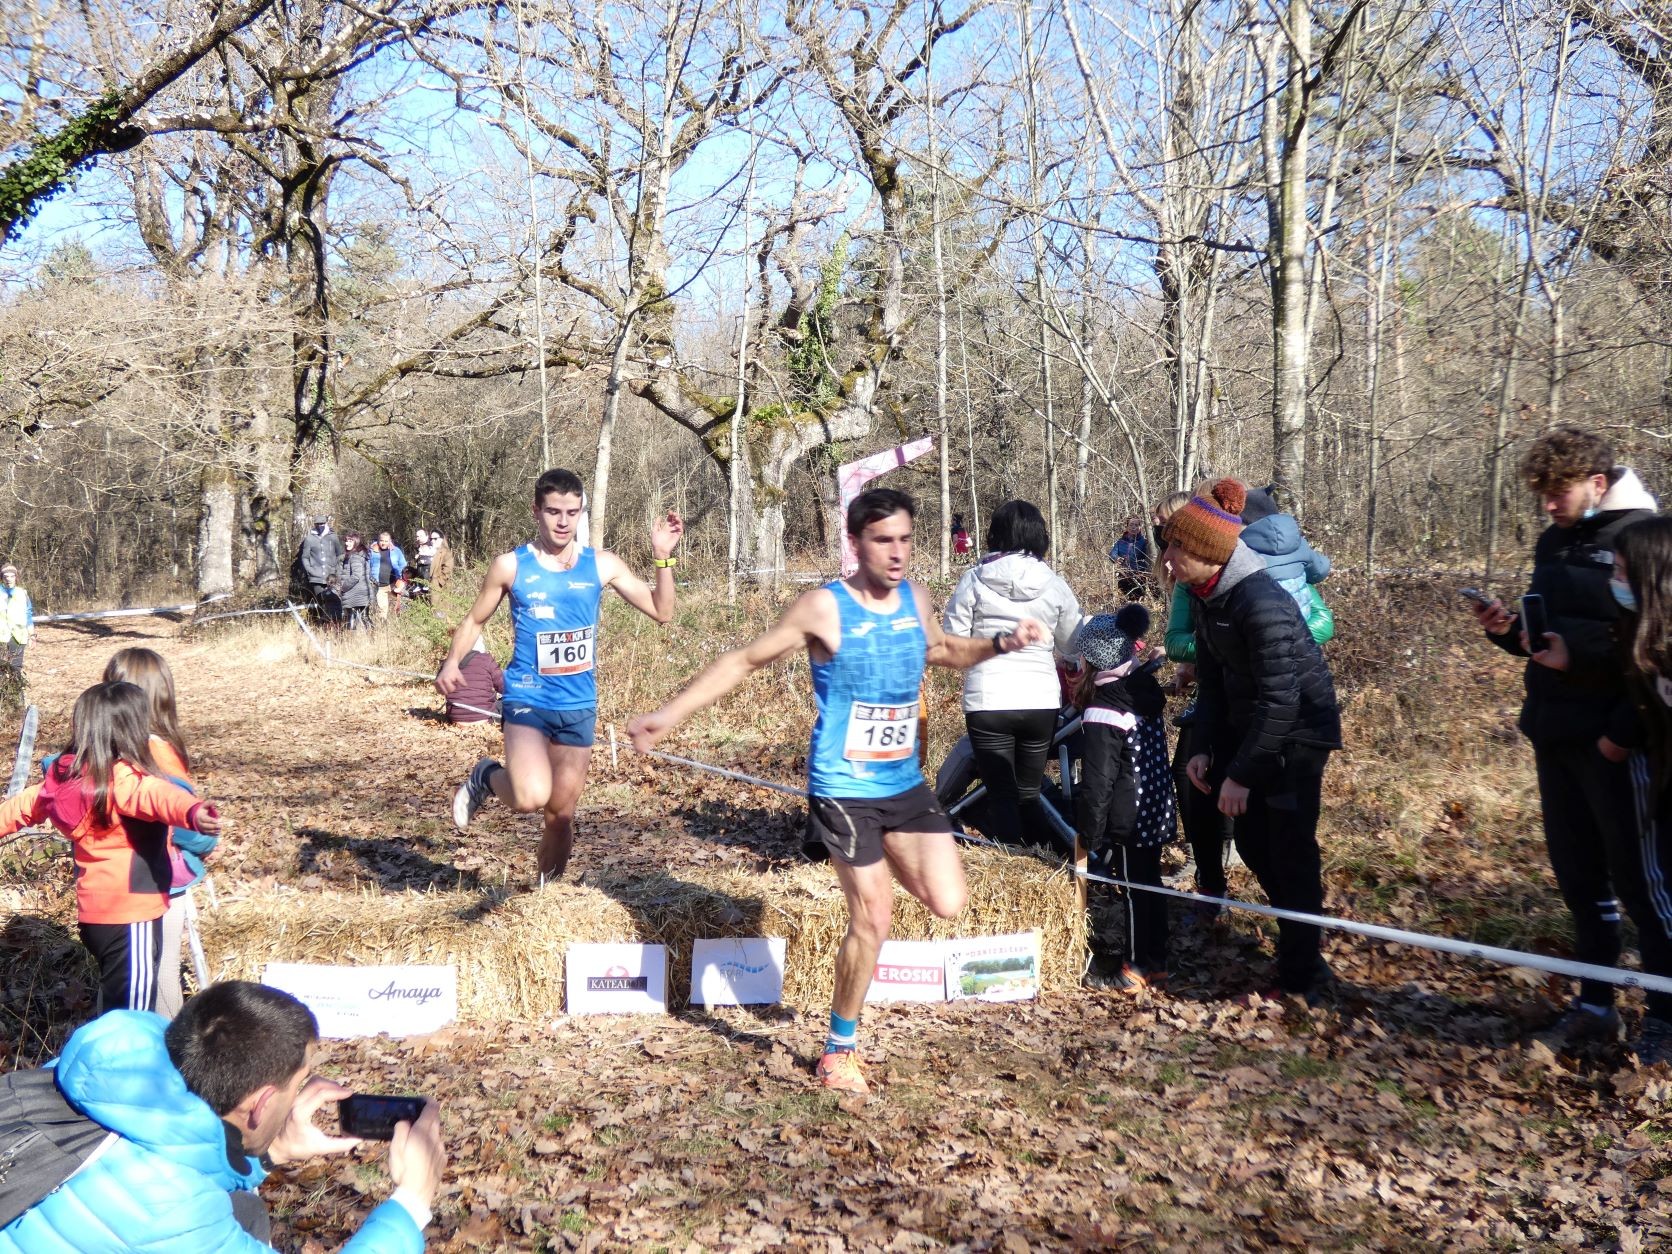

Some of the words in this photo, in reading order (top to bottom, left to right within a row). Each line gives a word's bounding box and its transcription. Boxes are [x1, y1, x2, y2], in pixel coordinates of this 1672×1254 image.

[550, 644, 587, 664] 160
[864, 724, 908, 747] 188
[878, 967, 939, 983] EROSKI
[368, 980, 443, 1006] Amaya
